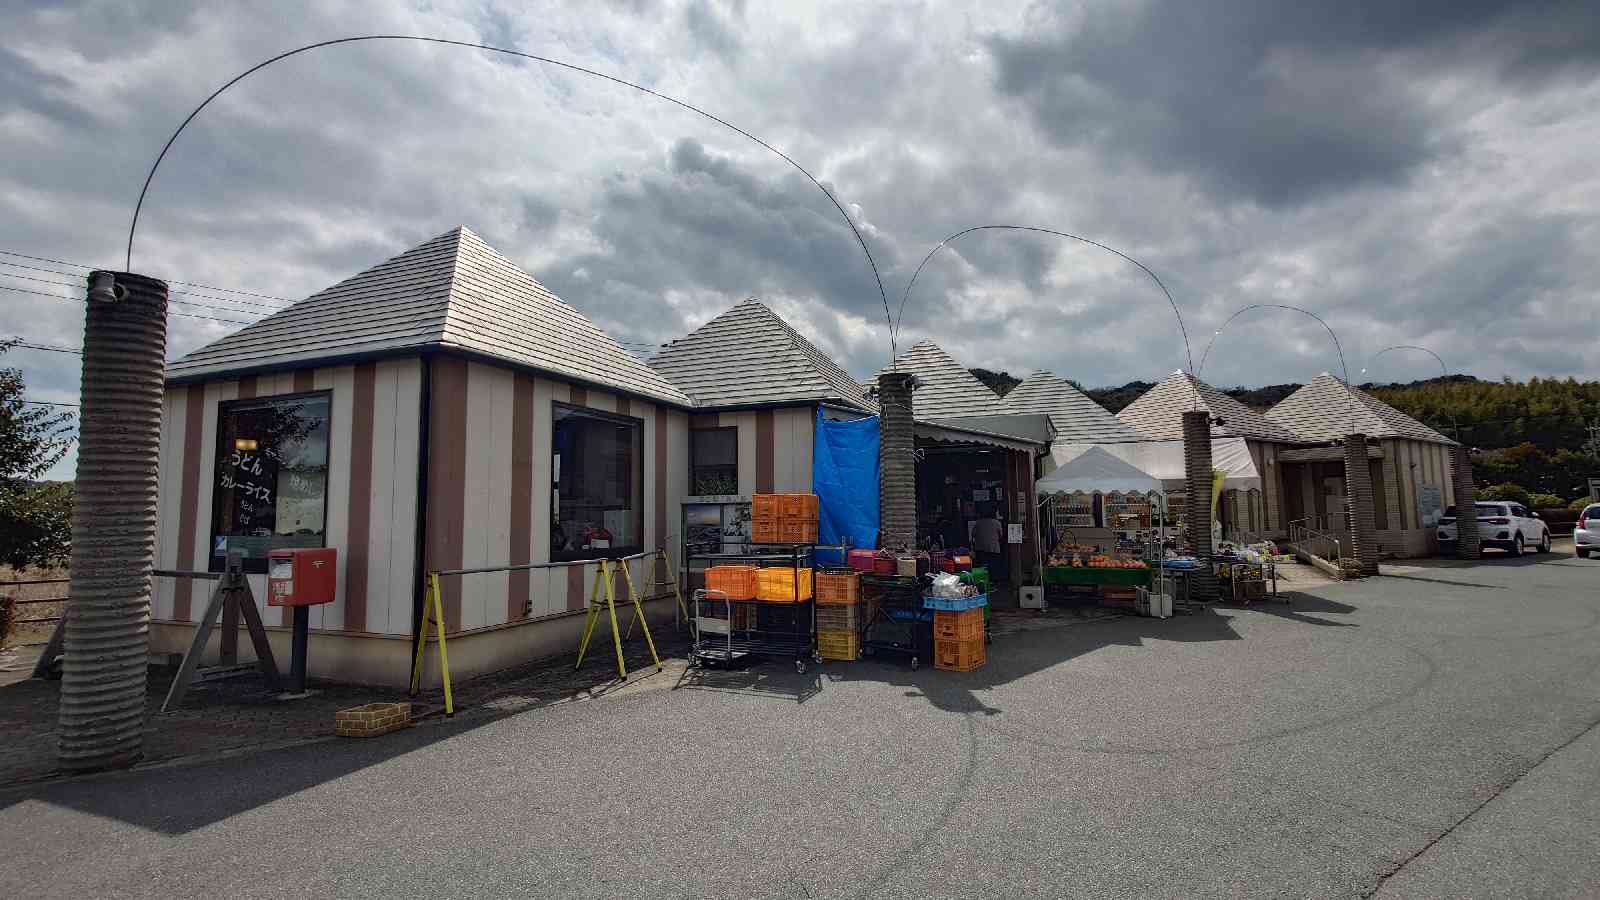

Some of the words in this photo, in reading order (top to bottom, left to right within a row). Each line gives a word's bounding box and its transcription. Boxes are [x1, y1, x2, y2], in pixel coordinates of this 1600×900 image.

[231, 449, 263, 476] うどん
[220, 471, 272, 504] カレーライス
